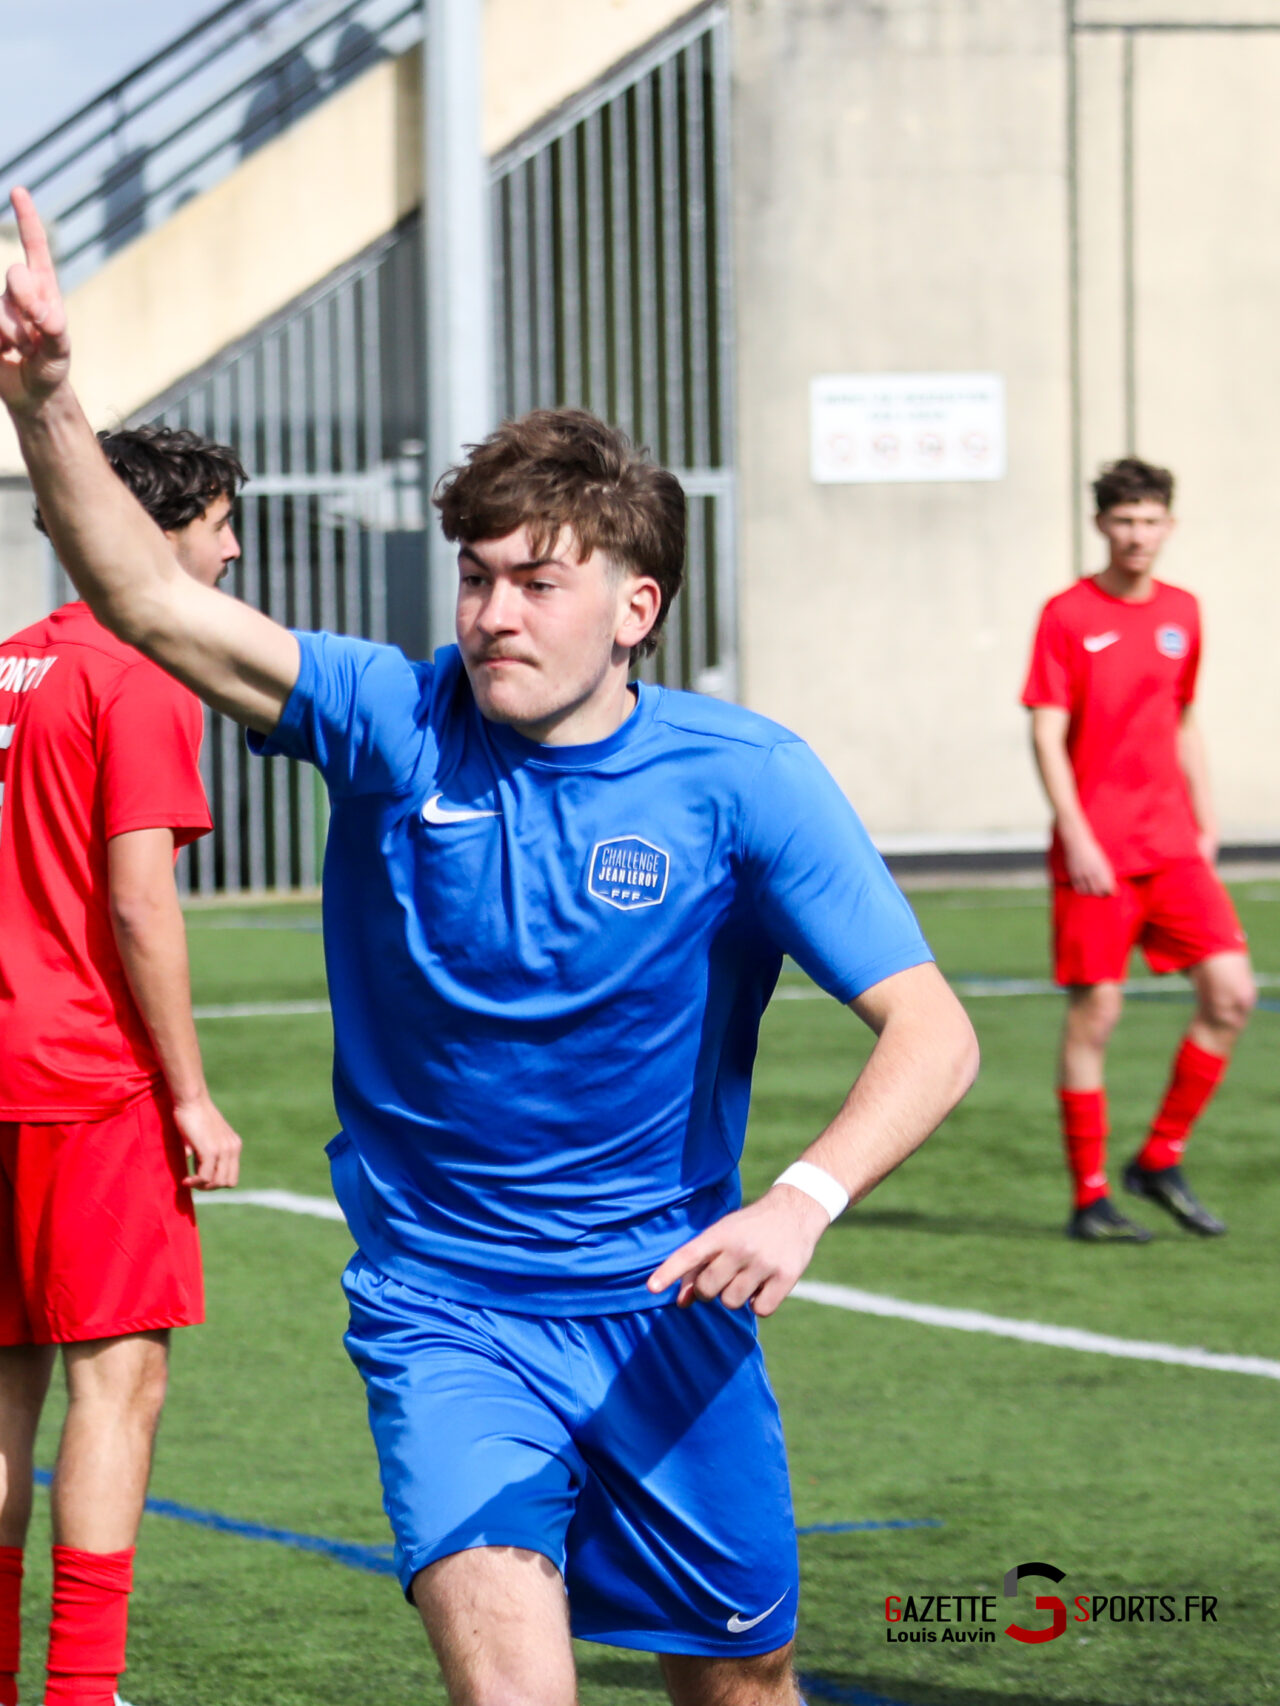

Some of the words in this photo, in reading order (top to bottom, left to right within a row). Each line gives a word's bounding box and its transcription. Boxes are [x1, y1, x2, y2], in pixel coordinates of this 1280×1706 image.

[601, 848, 659, 872] CHALLENGE
[598, 866, 626, 883] JEAN
[627, 869, 658, 888] LEROY
